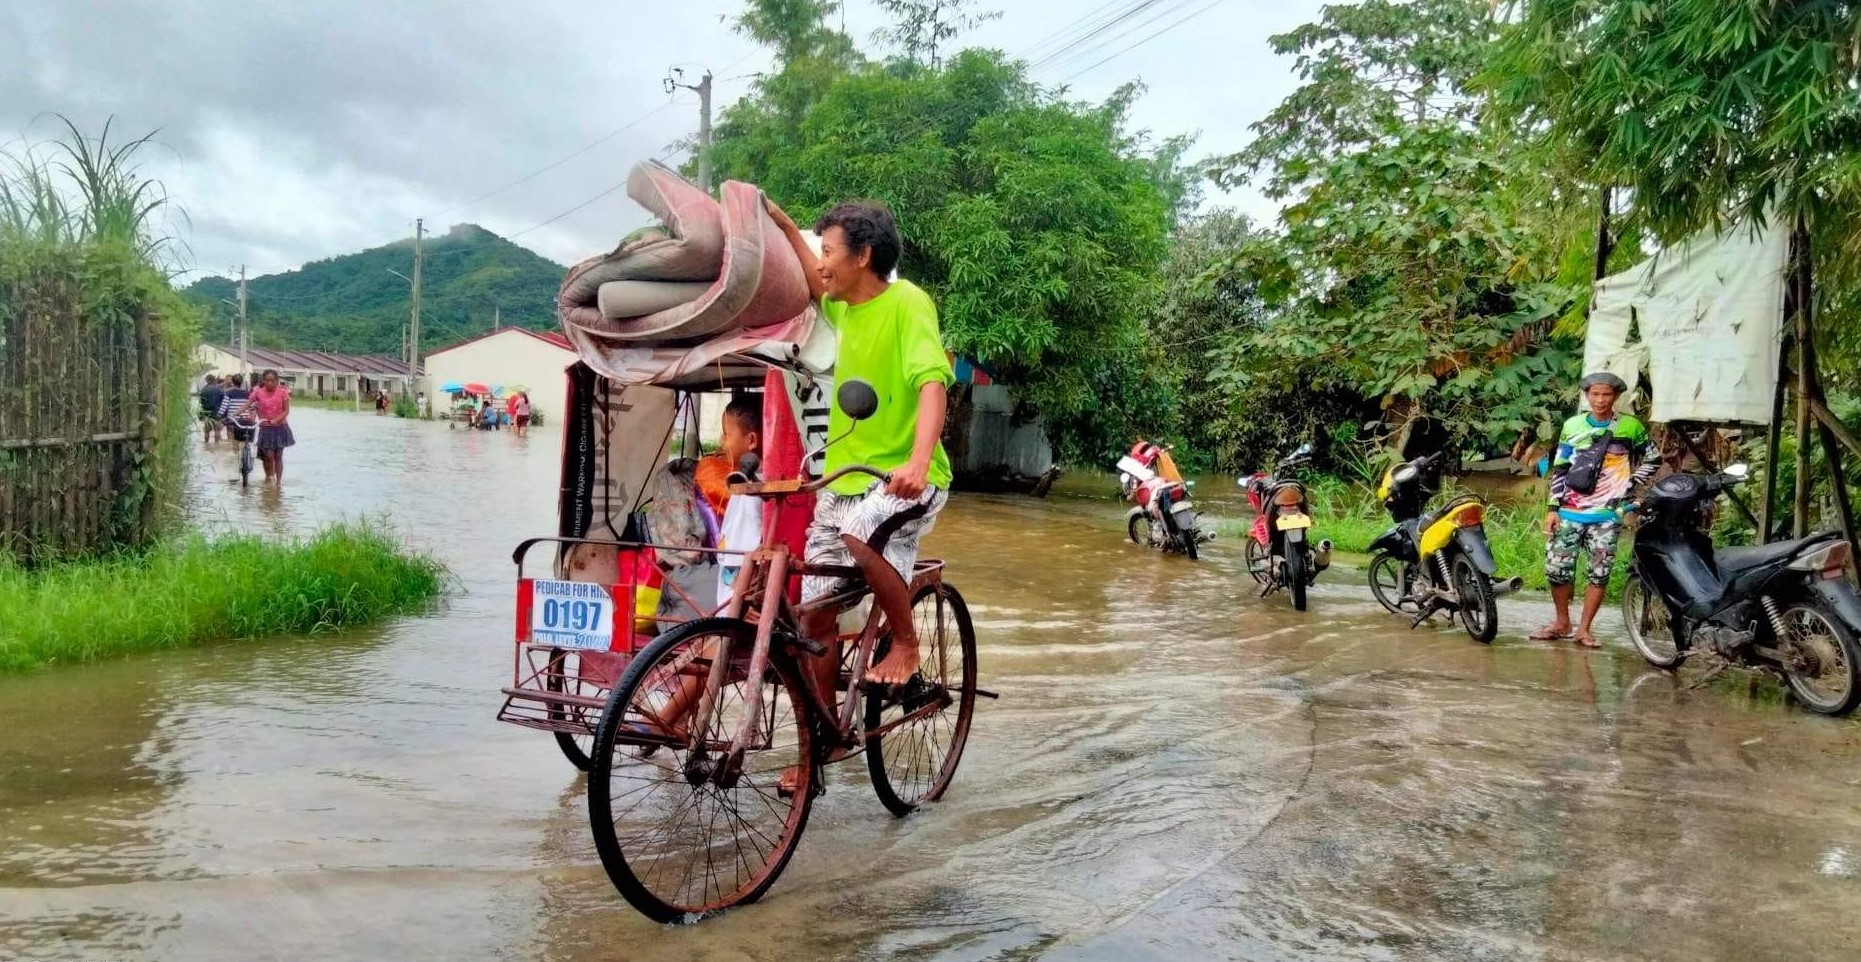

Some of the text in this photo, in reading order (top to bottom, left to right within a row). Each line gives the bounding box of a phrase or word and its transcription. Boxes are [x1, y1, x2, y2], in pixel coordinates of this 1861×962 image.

[536, 581, 570, 596] PEDICAB
[573, 583, 588, 597] FOR
[544, 598, 601, 630] 0197
